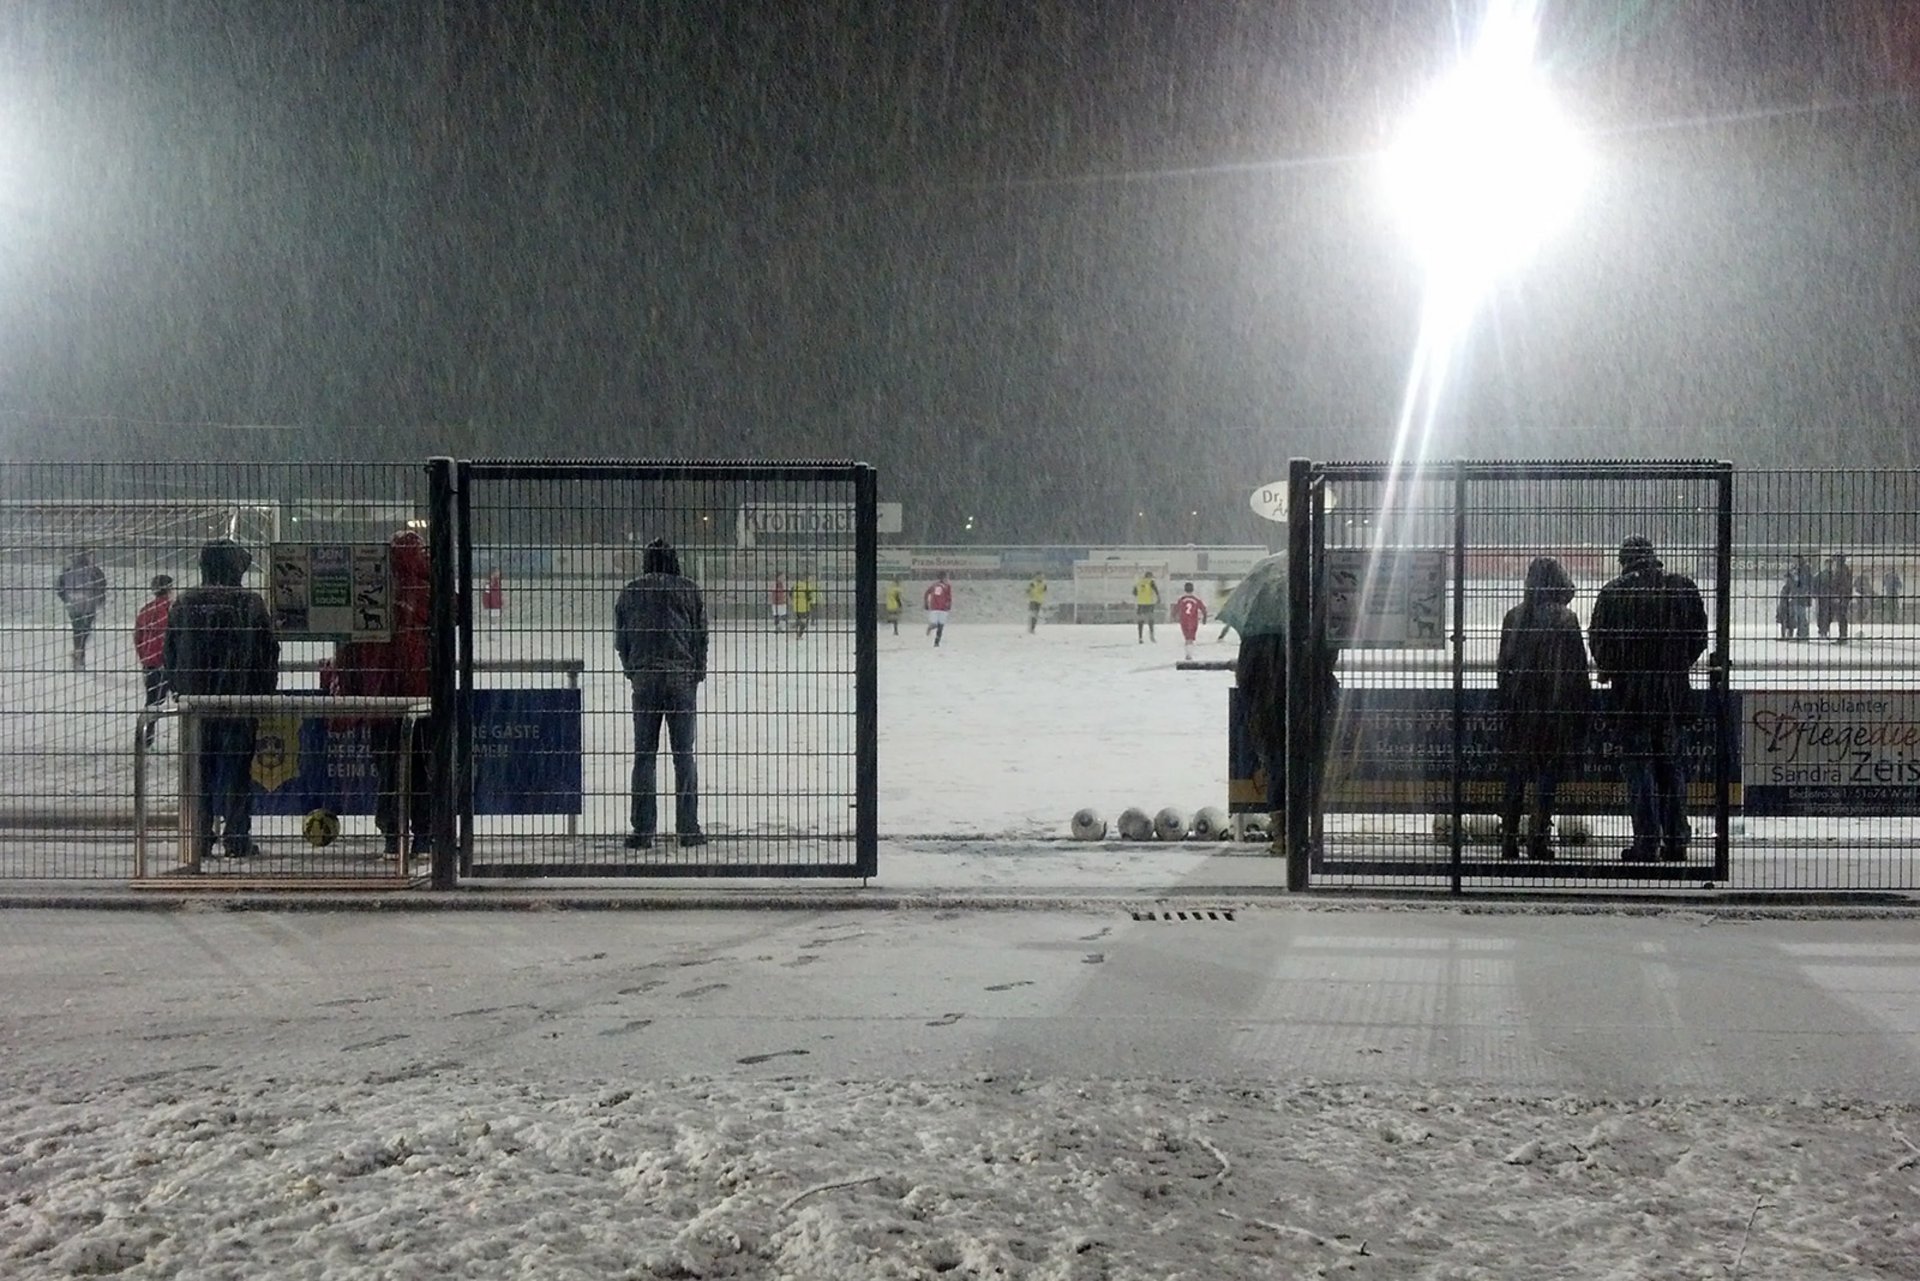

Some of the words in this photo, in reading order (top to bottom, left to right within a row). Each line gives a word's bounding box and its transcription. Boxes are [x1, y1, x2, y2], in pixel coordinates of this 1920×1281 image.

[1263, 489, 1284, 504] Dr.
[745, 505, 882, 532] Krombach
[1185, 602, 1192, 615] 2
[1792, 699, 1889, 713] Ambulanter
[491, 722, 541, 739] GÄSTE
[1772, 765, 1842, 783] Sandra
